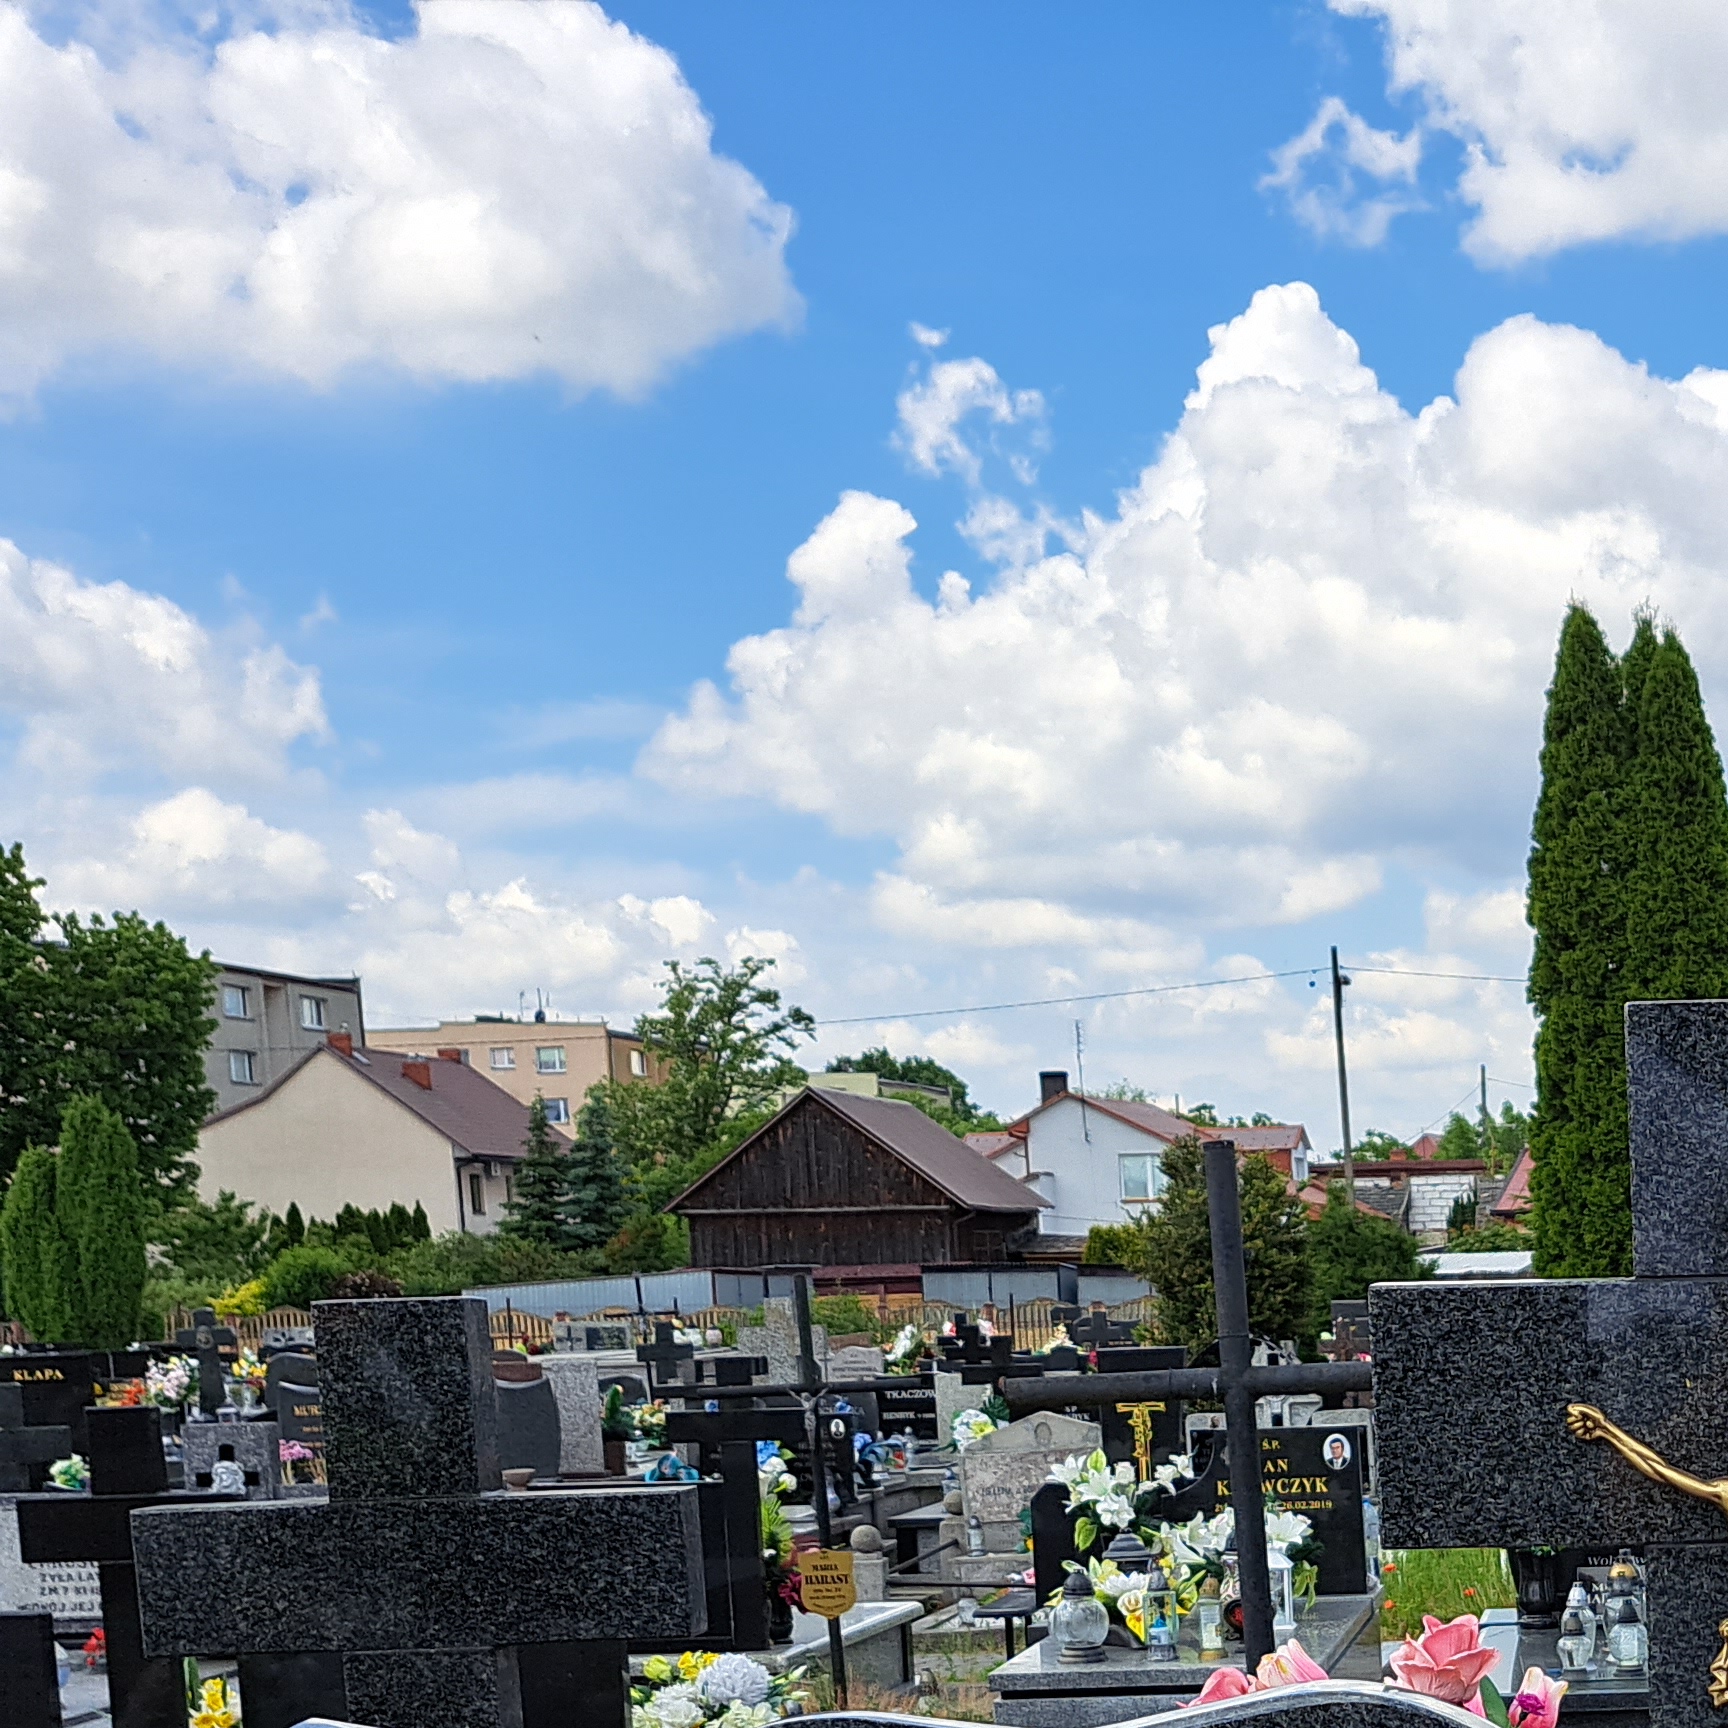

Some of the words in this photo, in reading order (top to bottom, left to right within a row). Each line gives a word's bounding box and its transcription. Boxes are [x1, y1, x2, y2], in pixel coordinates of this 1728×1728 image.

[12, 1368, 65, 1381] KLAPA
[885, 1389, 937, 1400] TKACZOW
[1263, 1458, 1289, 1473] AN
[1216, 1476, 1329, 1497] KWCZYK
